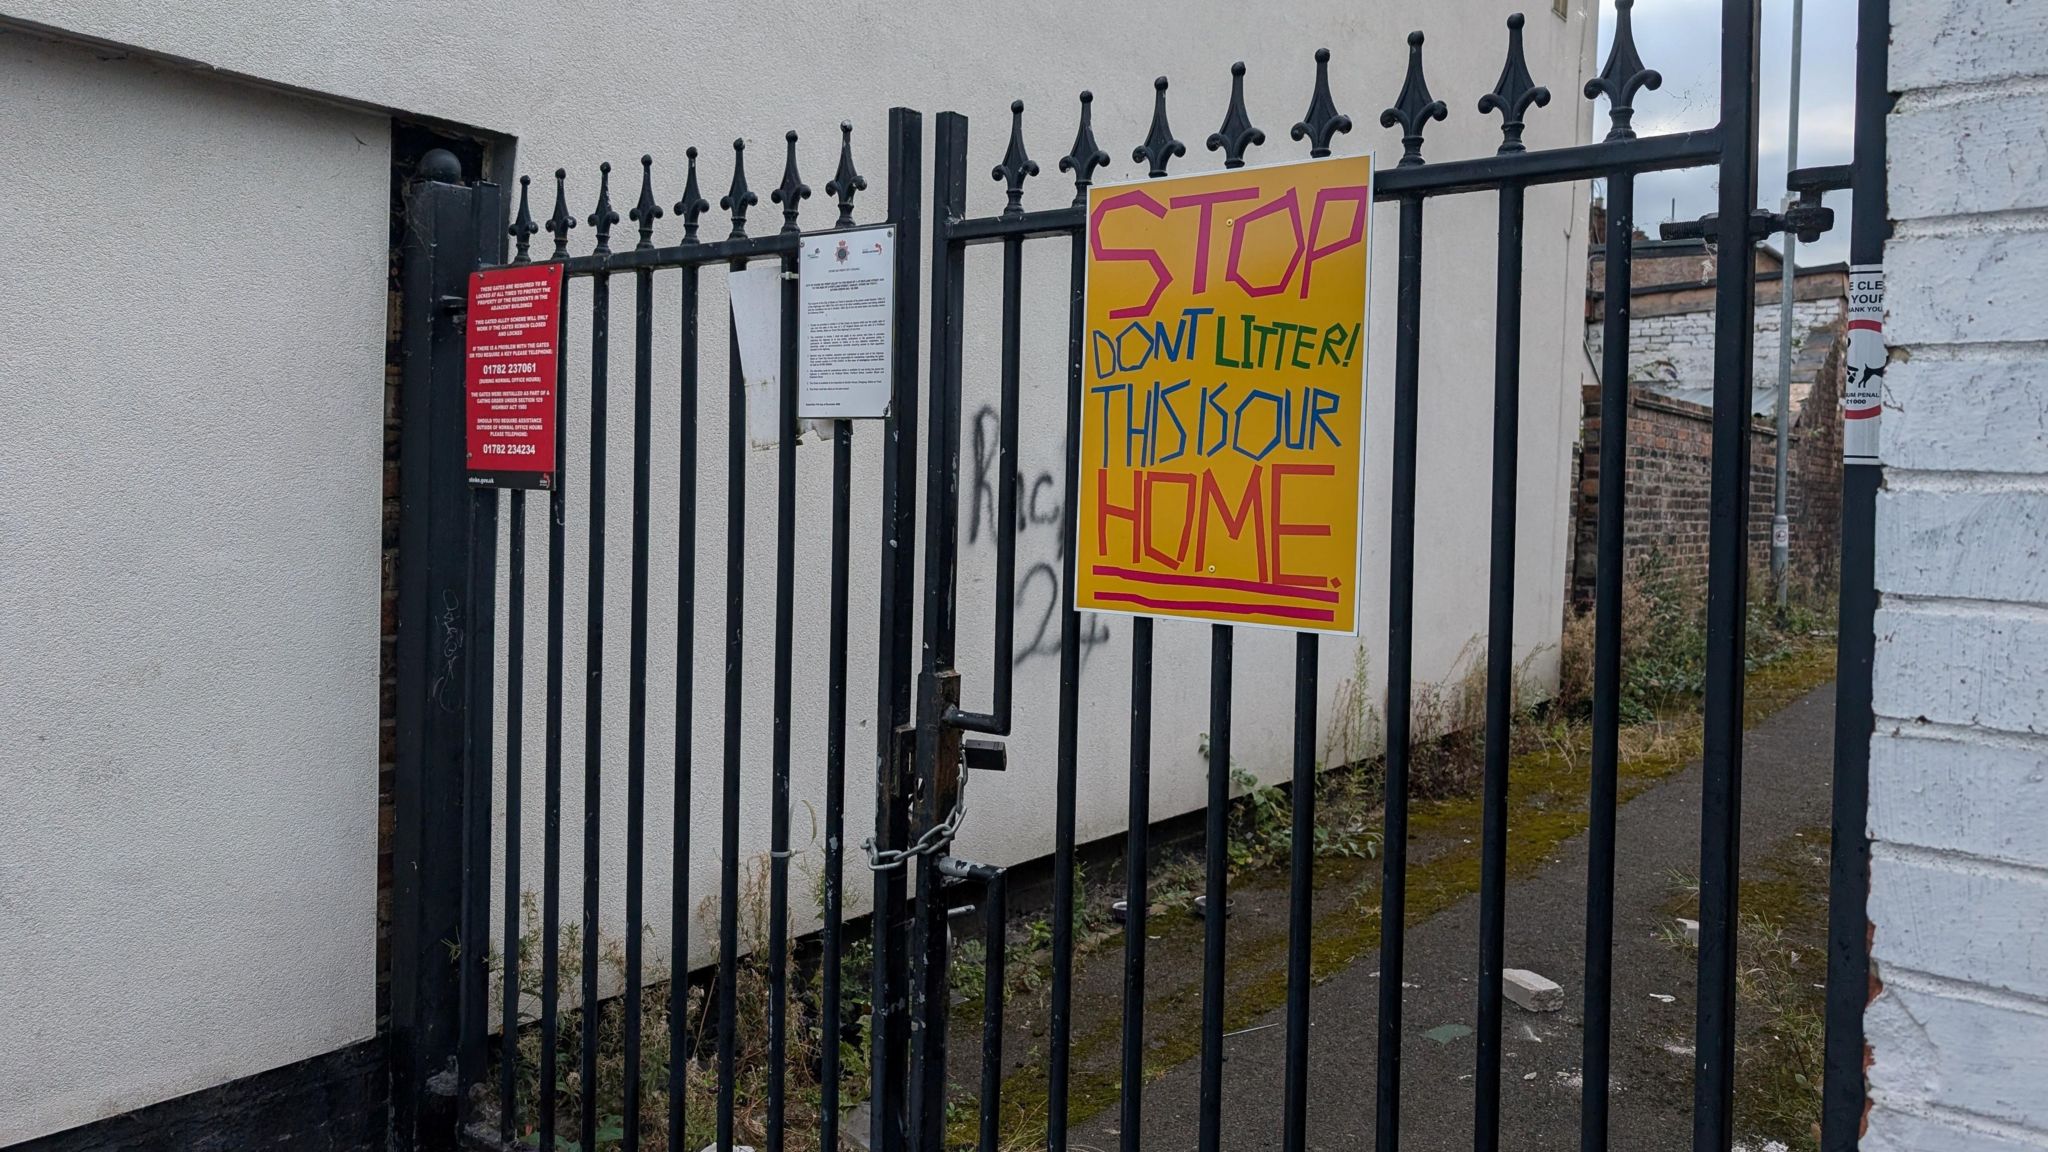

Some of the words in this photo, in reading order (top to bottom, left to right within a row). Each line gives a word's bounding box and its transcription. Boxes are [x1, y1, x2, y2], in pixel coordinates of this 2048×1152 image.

[1089, 185, 1368, 320] STOP
[1858, 281, 1883, 290] CLE
[483, 364, 506, 374] 01782
[508, 363, 536, 373] 237061
[1092, 307, 1215, 379] DONT
[1215, 314, 1362, 370] LITTER!
[483, 444, 505, 454] 01782
[507, 444, 535, 454] 234234
[1090, 379, 1191, 468] THIS
[1197, 381, 1229, 458] IS
[1233, 386, 1342, 461] OUR
[1097, 463, 1342, 588] HOME.
